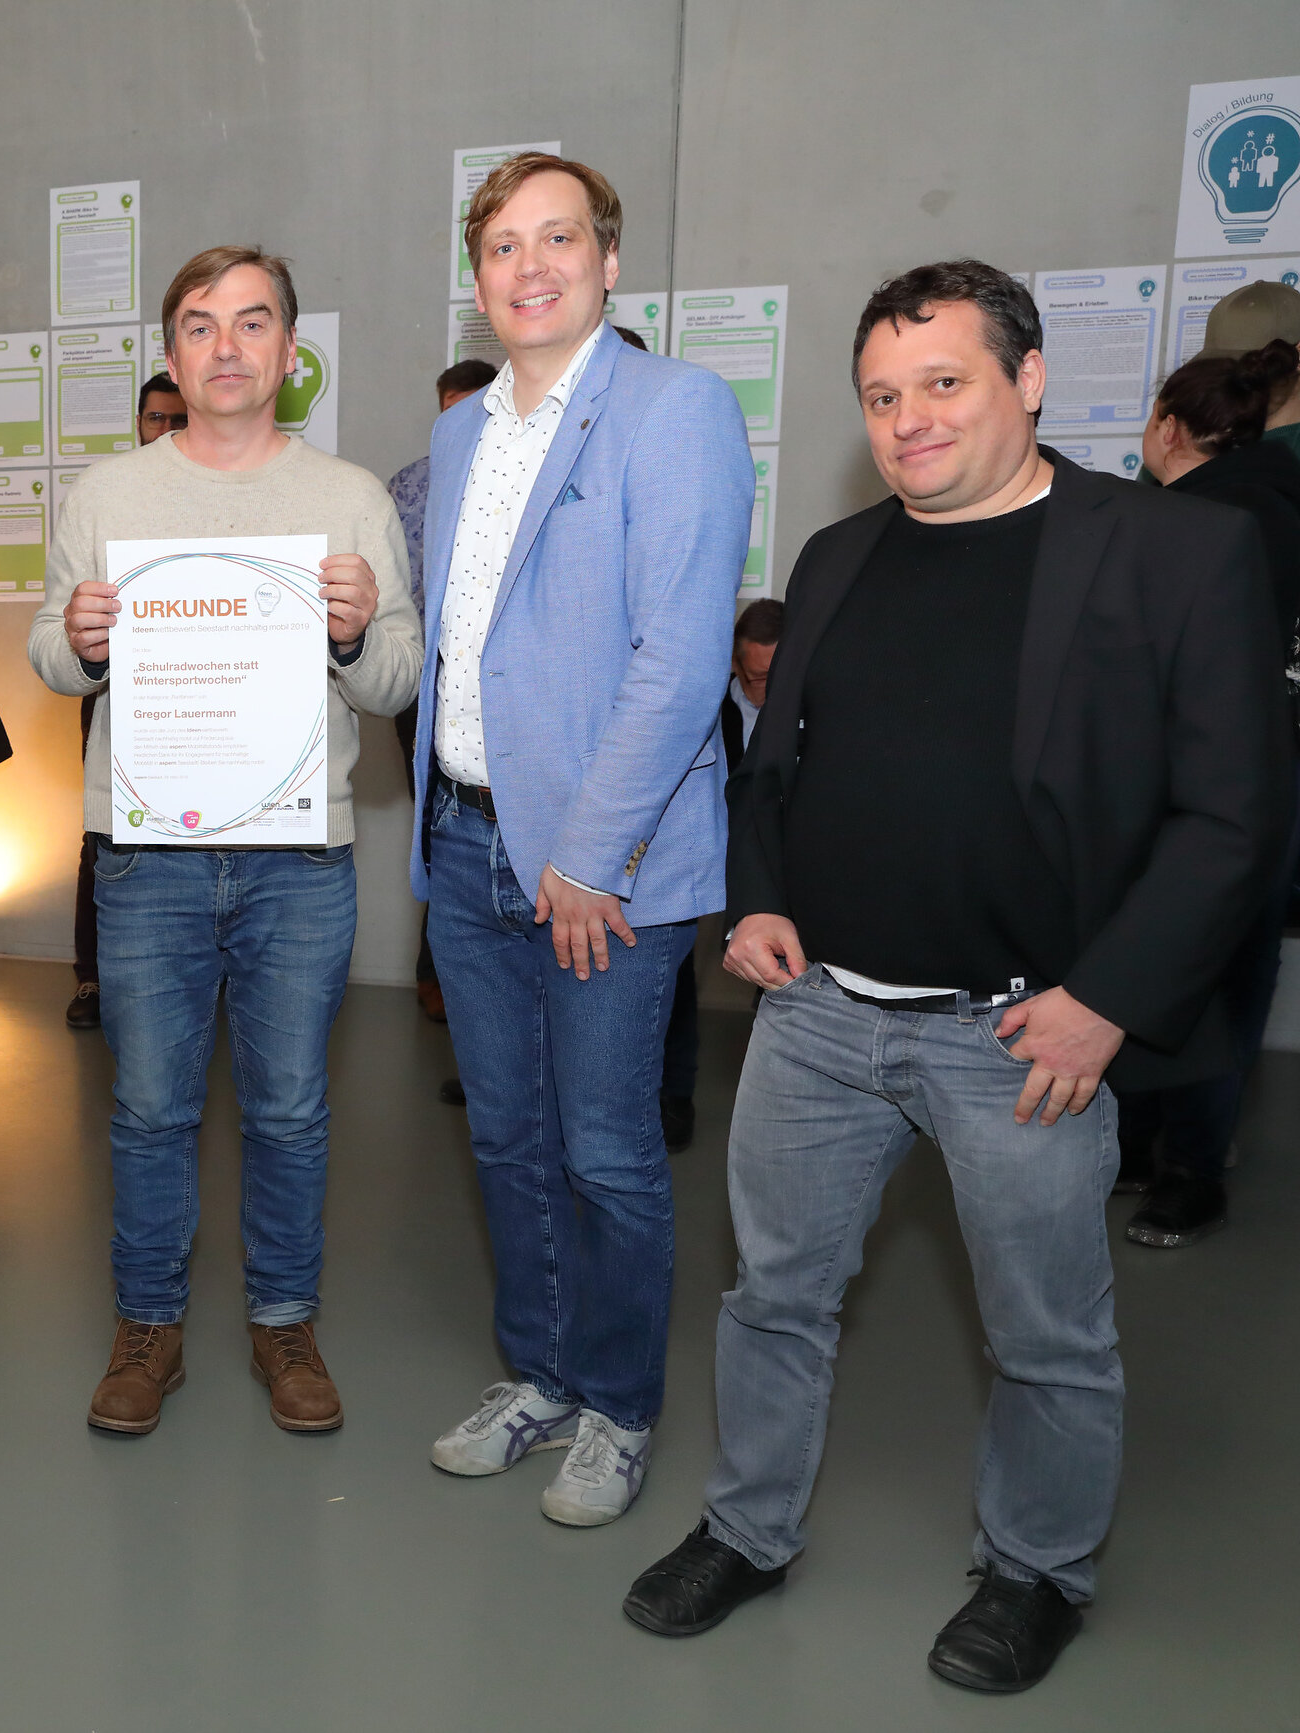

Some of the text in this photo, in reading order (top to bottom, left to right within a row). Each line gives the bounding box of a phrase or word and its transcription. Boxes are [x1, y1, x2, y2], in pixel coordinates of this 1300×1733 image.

[1192, 111, 1225, 138] Dialog
[1231, 92, 1274, 109] Bildung
[133, 598, 248, 619] URKUNDE
[132, 623, 310, 634] Ideenwettbewerb Seestadt nachhaltig mobil 2019
[133, 660, 259, 674] „Schulradwochen statt
[133, 675, 247, 687] Wintersportwochen“
[133, 709, 237, 720] Gregor Lauermann
